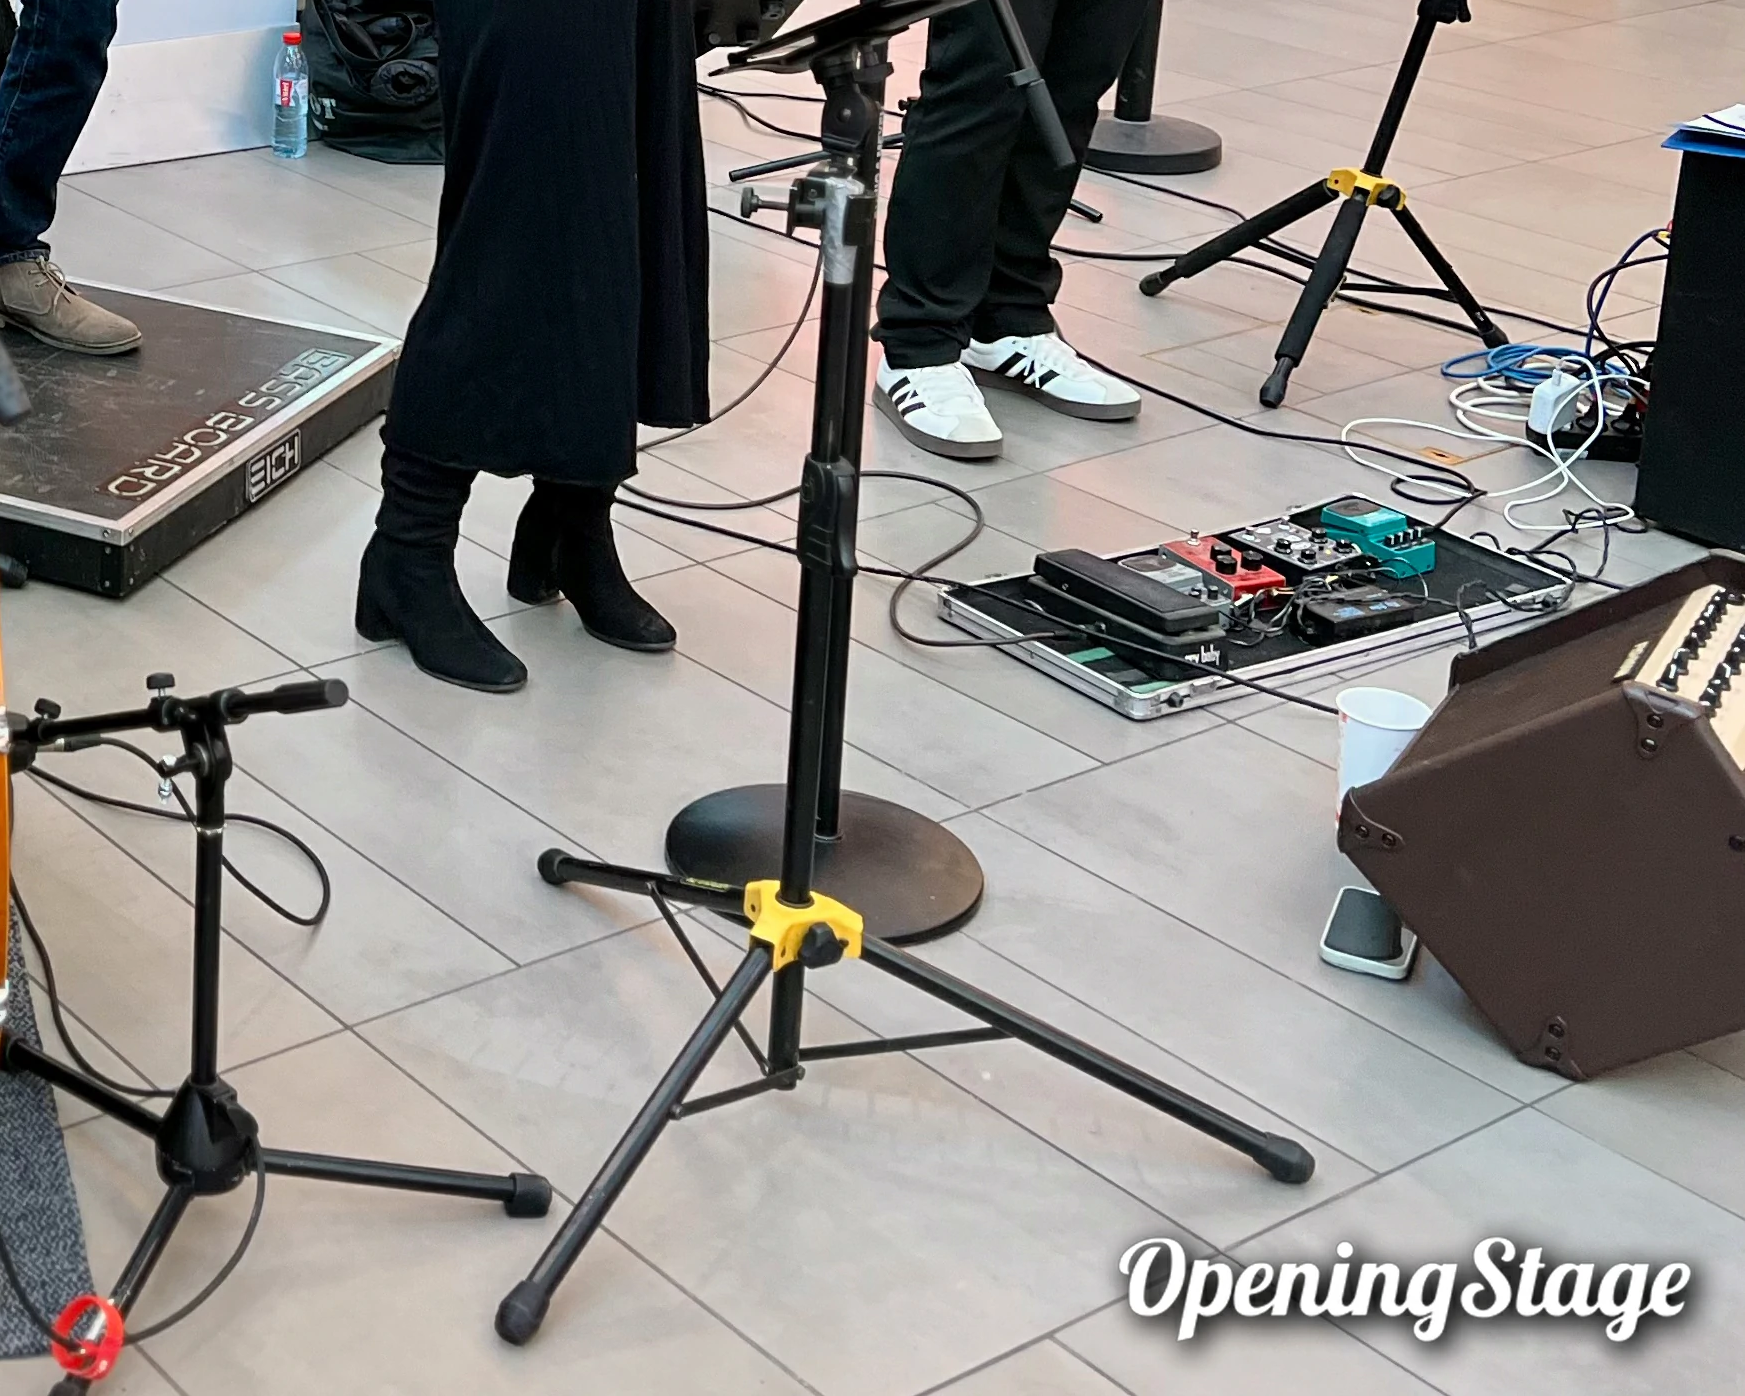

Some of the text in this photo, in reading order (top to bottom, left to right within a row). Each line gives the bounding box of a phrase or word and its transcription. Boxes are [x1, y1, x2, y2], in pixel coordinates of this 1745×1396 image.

[107, 348, 349, 497] BASS BOARD
[248, 436, 300, 501] EICH
